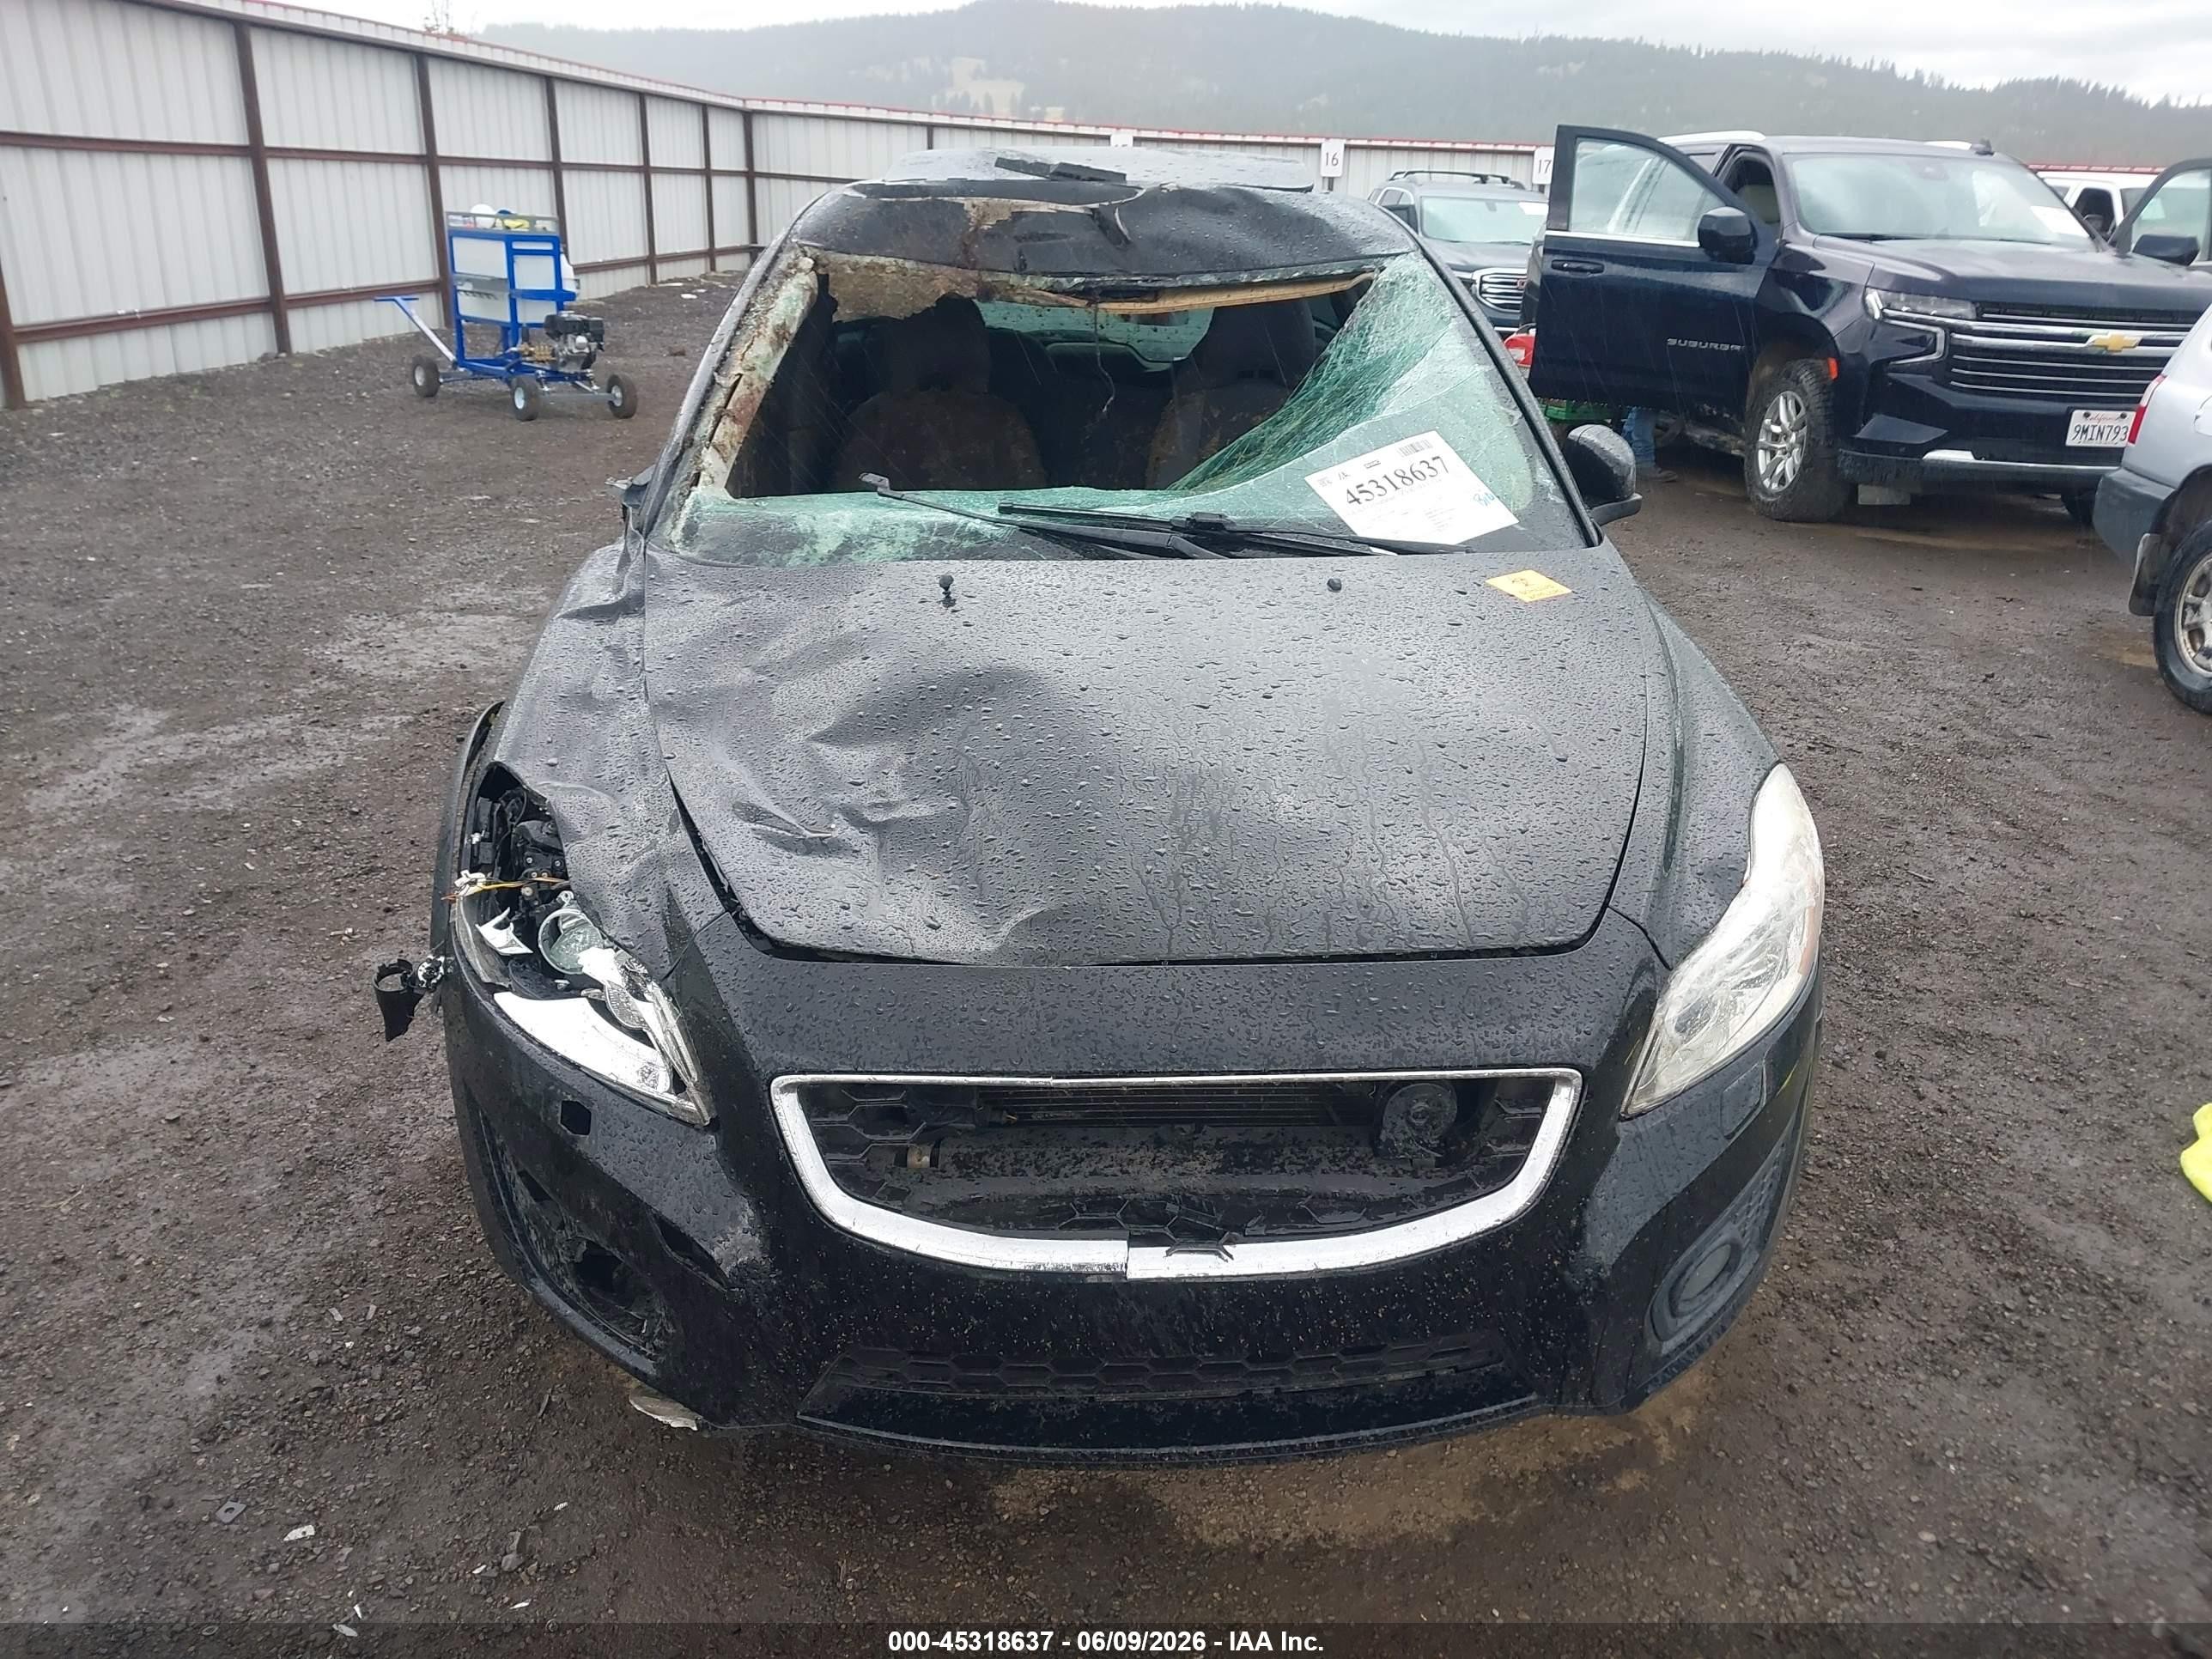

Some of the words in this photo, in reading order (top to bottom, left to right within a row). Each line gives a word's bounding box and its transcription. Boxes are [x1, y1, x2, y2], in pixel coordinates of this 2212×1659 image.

[1325, 151, 1340, 167] 16
[1538, 159, 1553, 173] 17
[1667, 337, 1745, 351] SUBURBA
[2071, 423, 2130, 441] 9MIN793
[1346, 455, 1449, 506] 45318637
